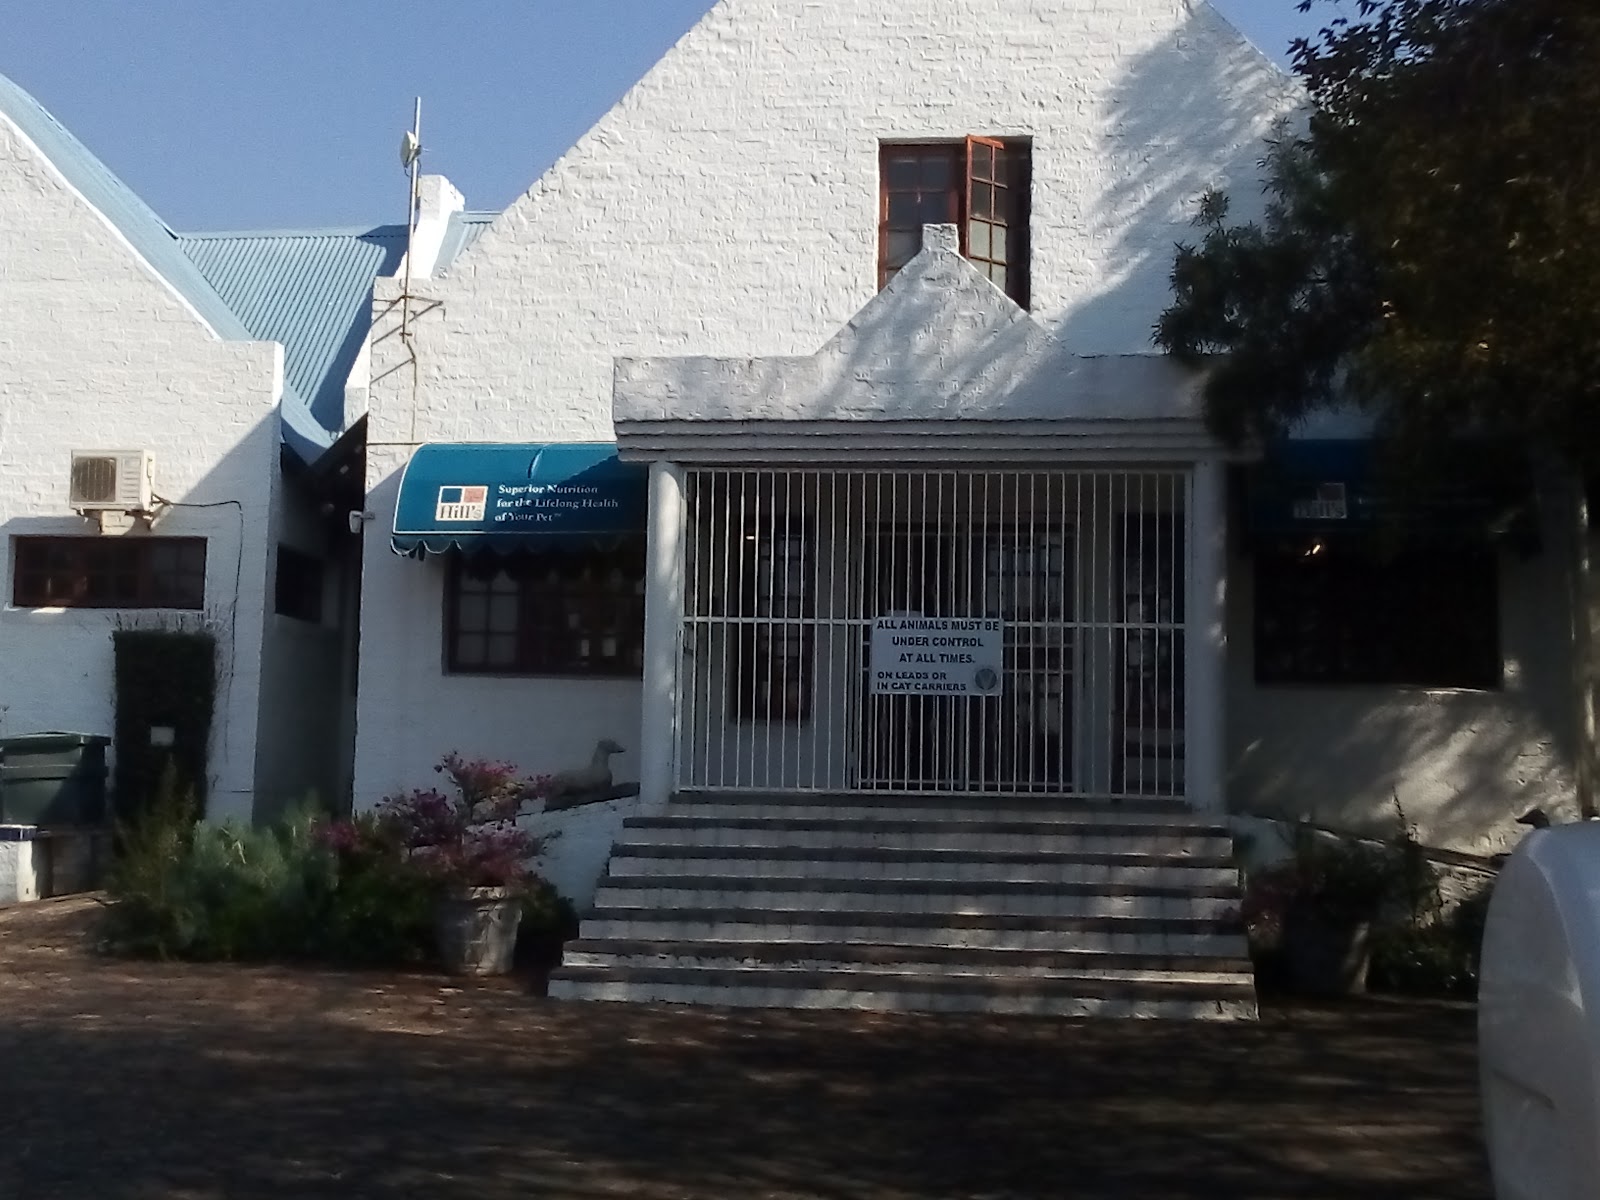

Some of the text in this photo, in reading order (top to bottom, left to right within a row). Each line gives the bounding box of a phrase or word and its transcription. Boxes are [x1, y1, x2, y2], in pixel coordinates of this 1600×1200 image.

[498, 484, 598, 495] Superior Nutrition
[497, 498, 619, 509] for the Lifelong Health
[440, 505, 482, 519] Hill's
[495, 512, 508, 522] of
[509, 512, 533, 521] Your
[877, 620, 999, 631] ALL ANIMALS MUST BE
[892, 636, 984, 647] UNDER CONTROL
[899, 653, 976, 663] AT ALL TIMES.
[877, 671, 947, 680] ON LEADS OR
[877, 682, 967, 691] IN CAT CARRIERS
